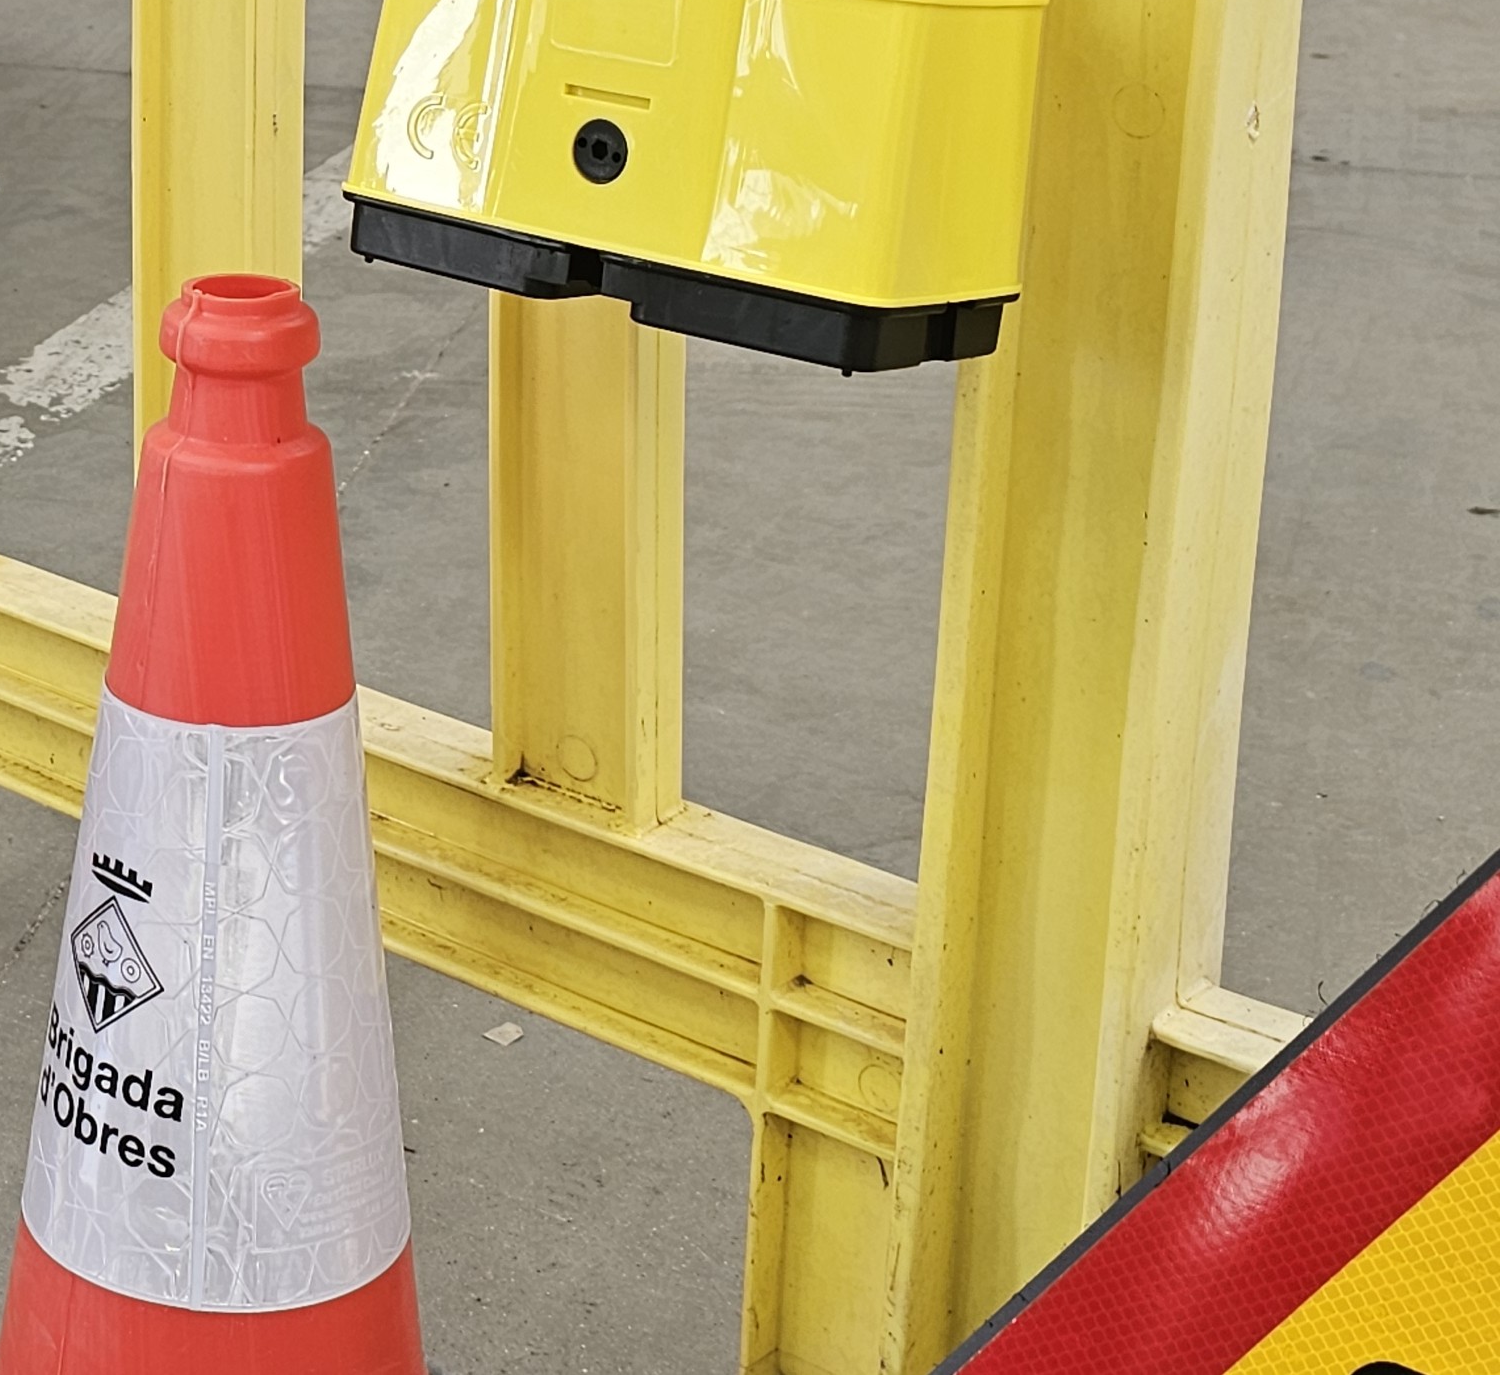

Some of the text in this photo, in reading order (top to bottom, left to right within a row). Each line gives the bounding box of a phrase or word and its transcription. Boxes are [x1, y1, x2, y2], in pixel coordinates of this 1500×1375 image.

[203, 935, 215, 960] EN
[200, 974, 213, 1025] 13422
[48, 1001, 184, 1123] Brigada
